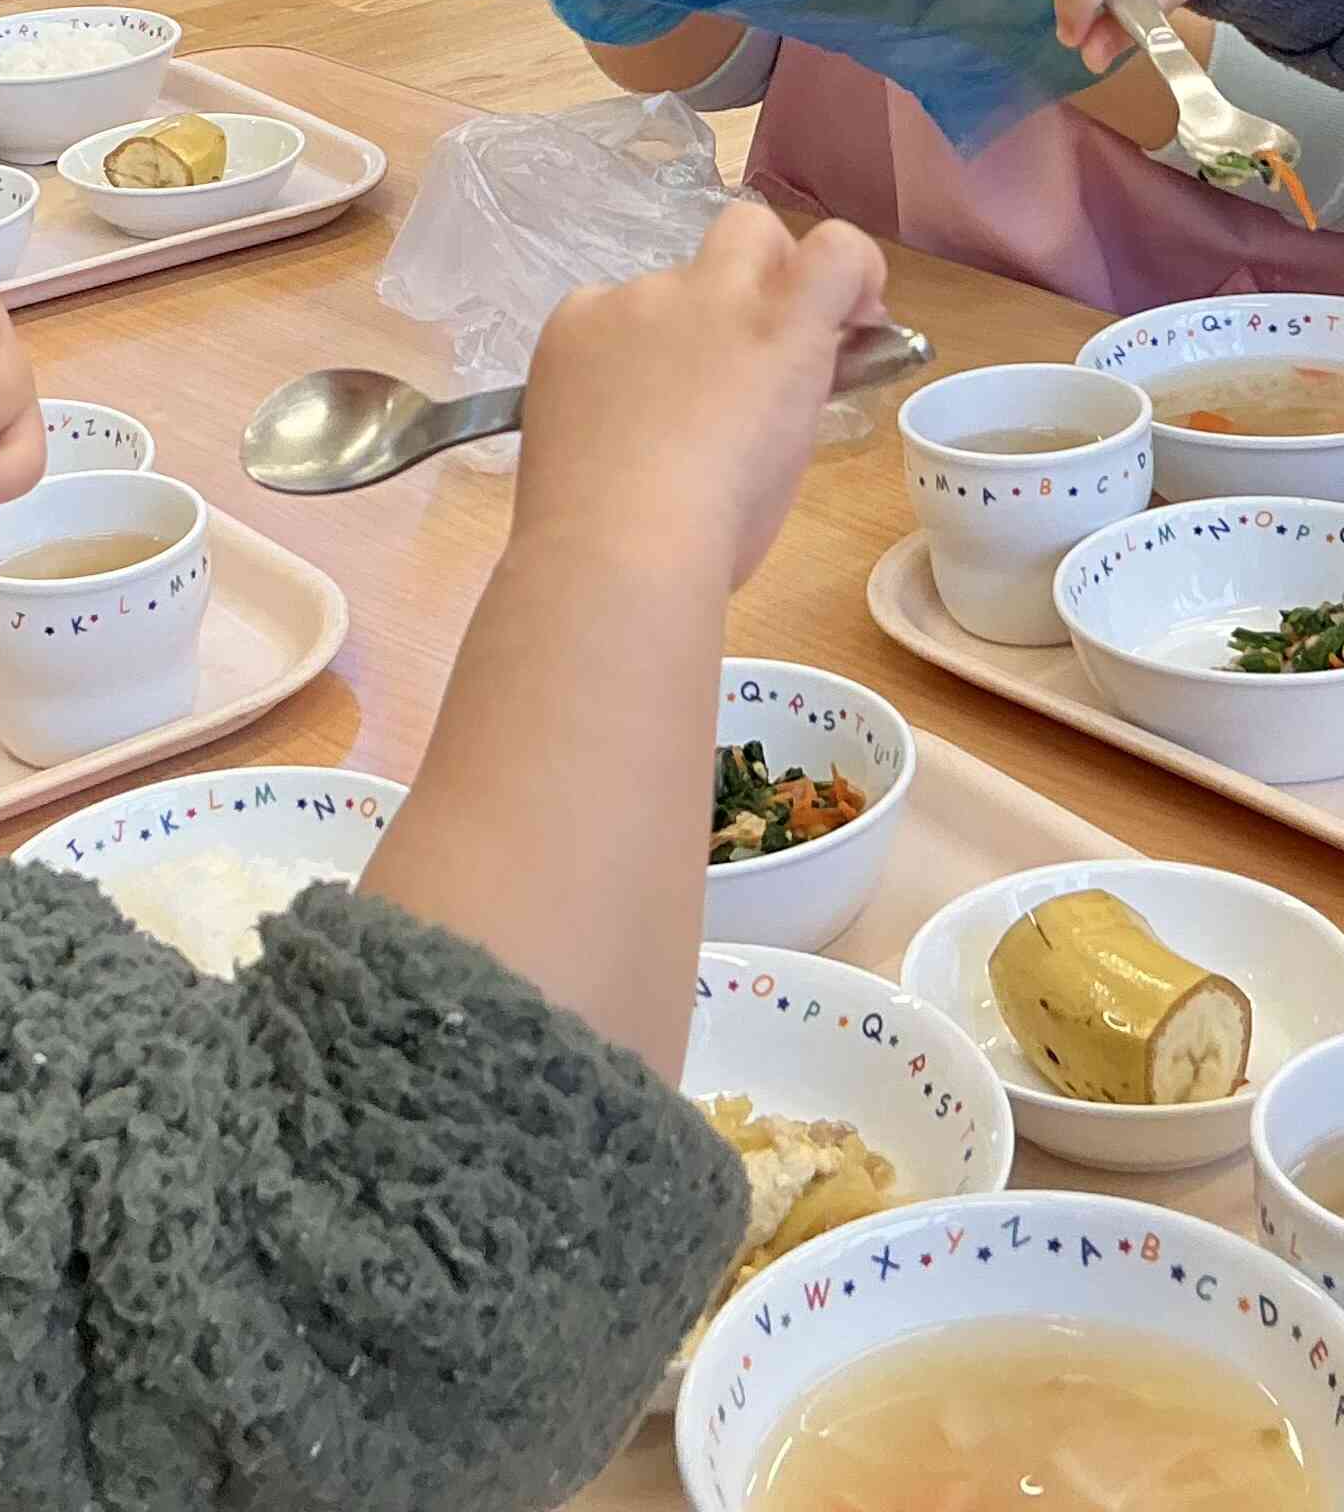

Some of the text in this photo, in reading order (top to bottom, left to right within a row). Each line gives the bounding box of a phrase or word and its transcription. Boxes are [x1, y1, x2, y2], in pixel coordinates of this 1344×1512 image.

[1113, 345, 1126, 365] N
[1136, 329, 1148, 345] O
[1202, 315, 1221, 331] Q
[1247, 313, 1262, 331] R
[1287, 319, 1301, 336] S
[1327, 315, 1341, 331] T
[85, 419, 96, 436] Z
[936, 474, 949, 493] M
[983, 488, 997, 505] A
[1039, 478, 1052, 496] B
[1096, 475, 1109, 494] C
[1100, 555, 1113, 576] K
[1126, 533, 1137, 551] L
[1158, 523, 1176, 545] M
[1208, 517, 1231, 540] N
[1255, 510, 1273, 528] O
[1296, 524, 1310, 541] P
[11, 612, 26, 629] J
[72, 616, 87, 635] K
[119, 596, 130, 615] L
[170, 575, 184, 597] M
[741, 681, 763, 703] Q
[788, 693, 804, 715] R
[824, 710, 836, 731] S
[66, 782, 377, 862] I J K L M N O
[752, 974, 775, 998] O
[803, 1000, 821, 1022] P
[862, 1013, 883, 1044] Q
[908, 1053, 926, 1077] R
[935, 1093, 952, 1118] S
[1289, 1234, 1303, 1261] L
[729, 1376, 746, 1410] U
[755, 1303, 772, 1336] V
[804, 1277, 831, 1311] W
[871, 1245, 900, 1280] X
[945, 1227, 965, 1255] Y
[1001, 1215, 1032, 1249] Z
[1081, 1236, 1102, 1267] A
[1141, 1232, 1160, 1262] B
[1196, 1274, 1218, 1301] C
[1259, 1294, 1278, 1326] D
[1309, 1337, 1329, 1370] E
